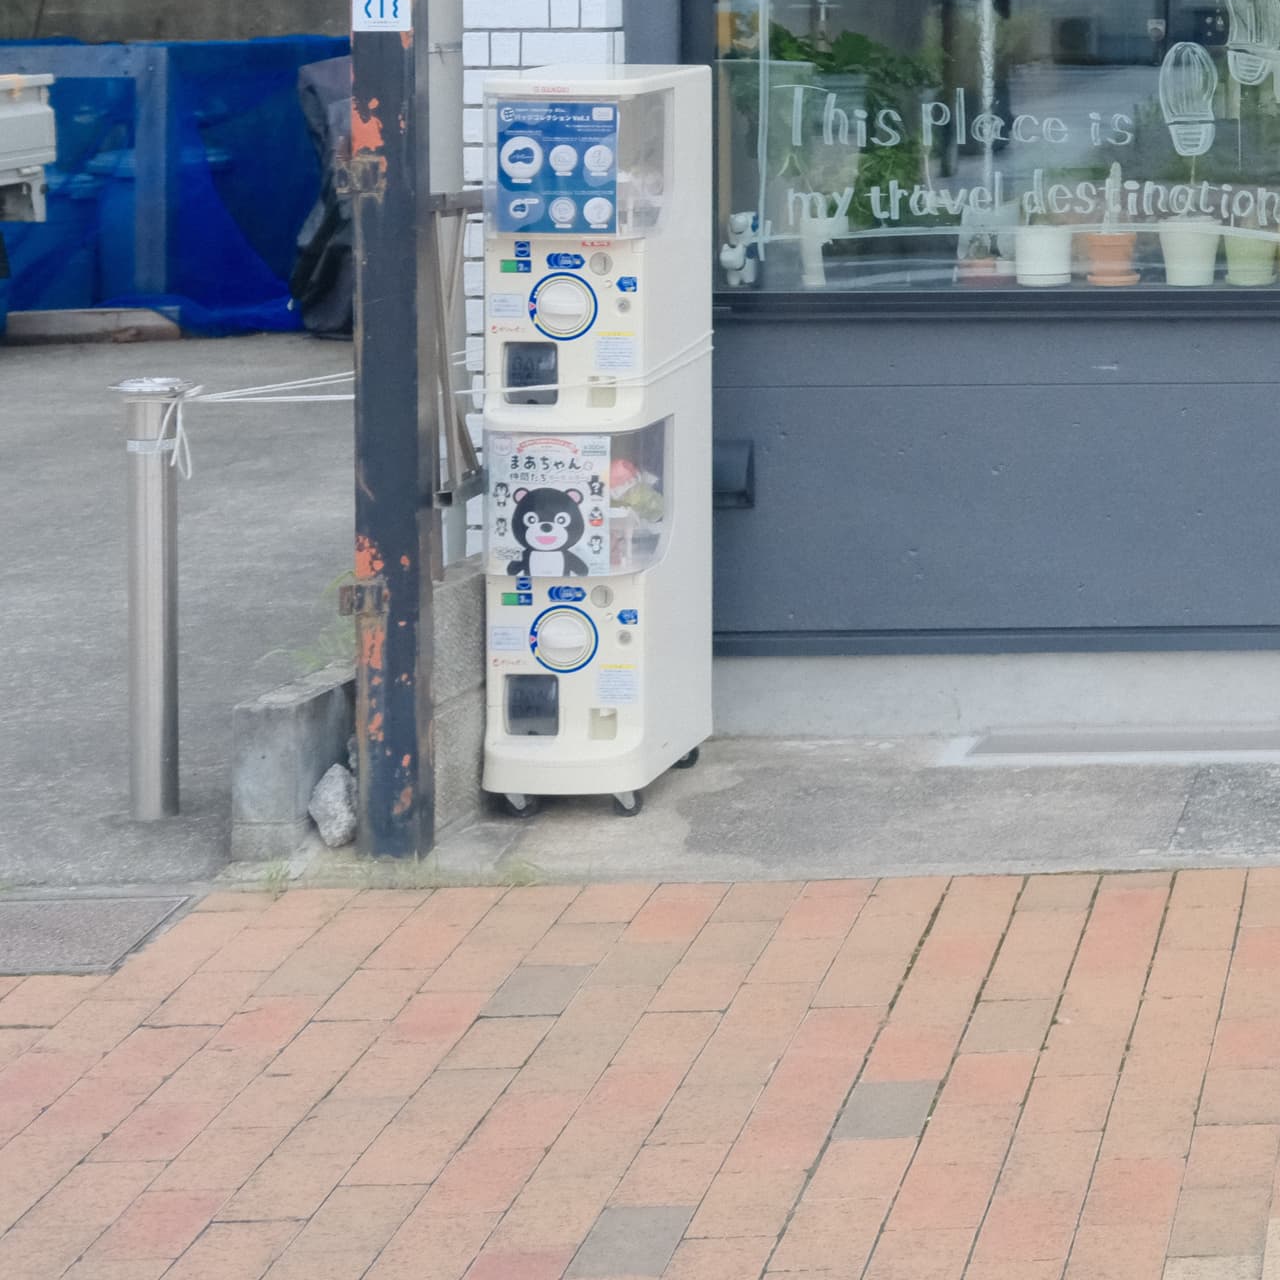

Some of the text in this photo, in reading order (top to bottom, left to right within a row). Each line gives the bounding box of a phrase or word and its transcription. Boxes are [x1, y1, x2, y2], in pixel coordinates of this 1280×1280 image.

[772, 84, 903, 147] This
[1088, 111, 1134, 147] is
[786, 185, 855, 226] my
[865, 170, 1001, 221] travel
[510, 455, 581, 471] まあちゃん
